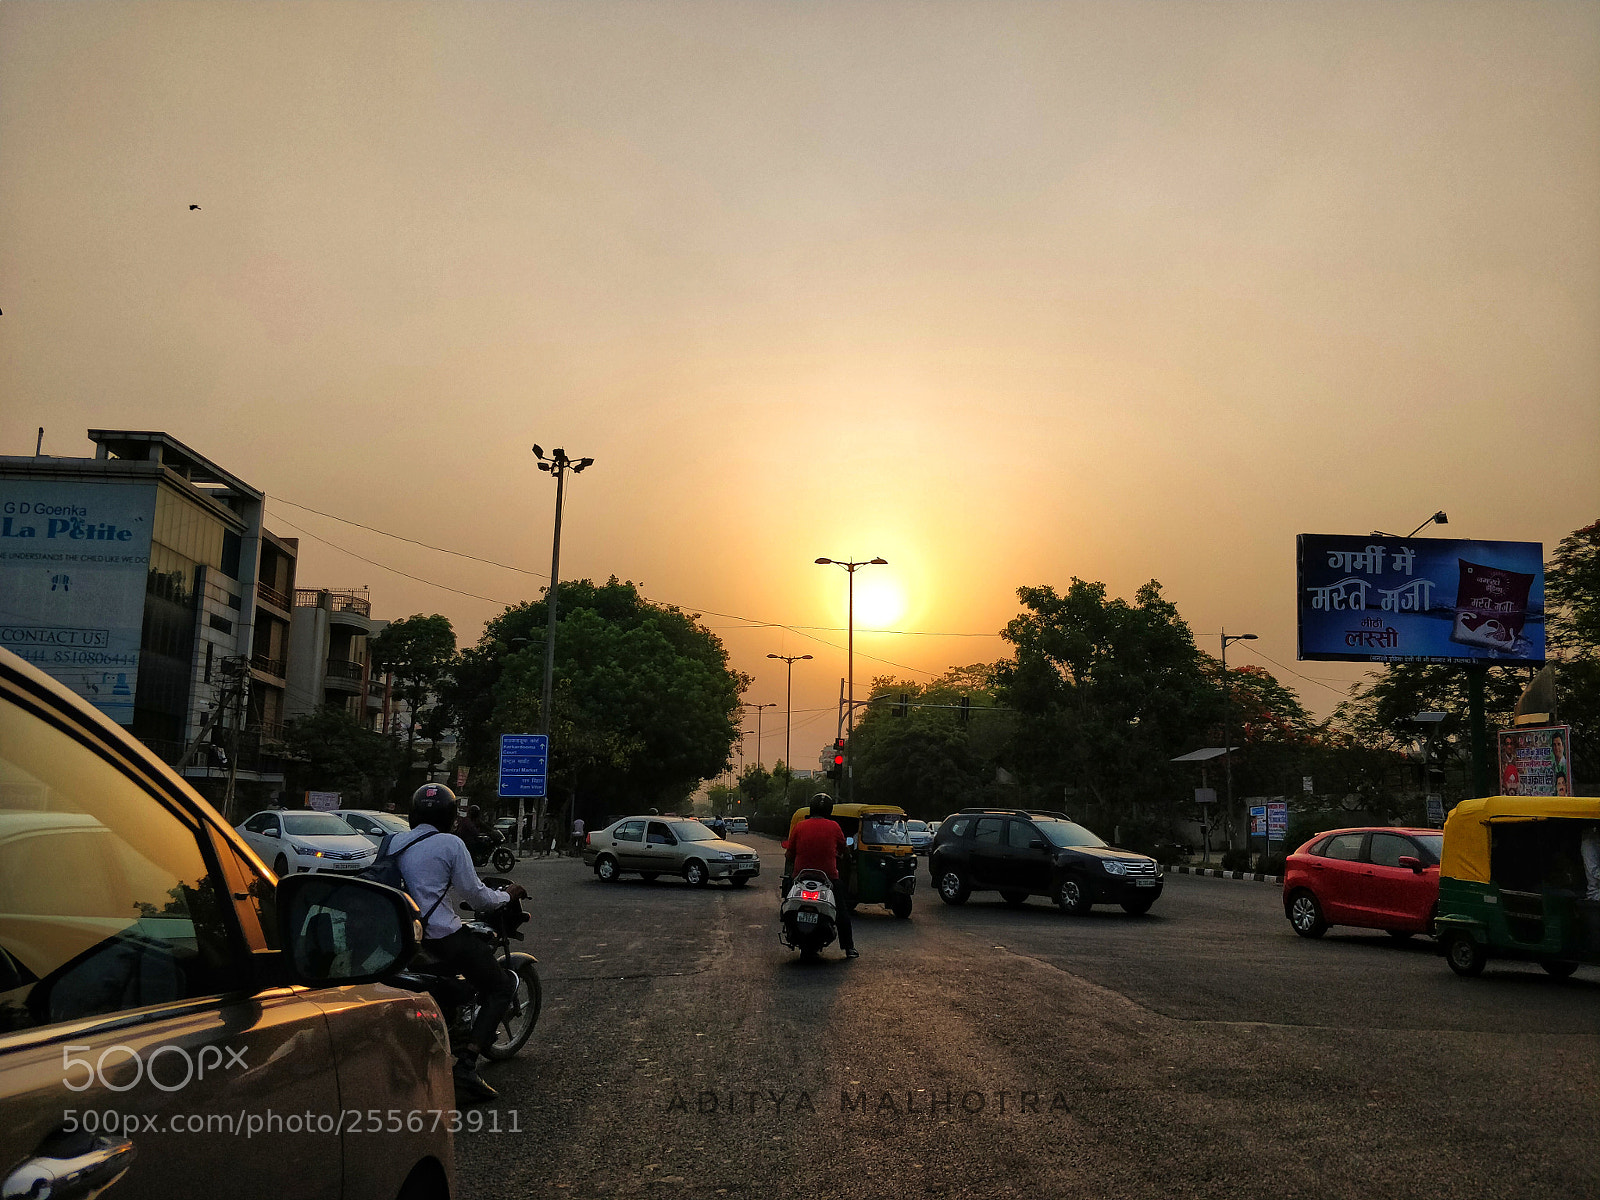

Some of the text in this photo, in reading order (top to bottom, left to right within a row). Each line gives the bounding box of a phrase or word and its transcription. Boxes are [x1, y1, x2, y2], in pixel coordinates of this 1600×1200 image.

[4, 502, 87, 517] G D Goenka
[2, 517, 133, 541] La Petite
[10, 552, 63, 561] UNDERSTANDS
[81, 555, 104, 563] CHILD
[105, 556, 120, 564] LIKE
[1326, 545, 1416, 575] गर्मी में
[1307, 576, 1435, 613] मस्त मजा
[1361, 617, 1384, 628] मीठी
[2, 628, 105, 645] CONTACT US:
[1345, 627, 1398, 648] लस्सी
